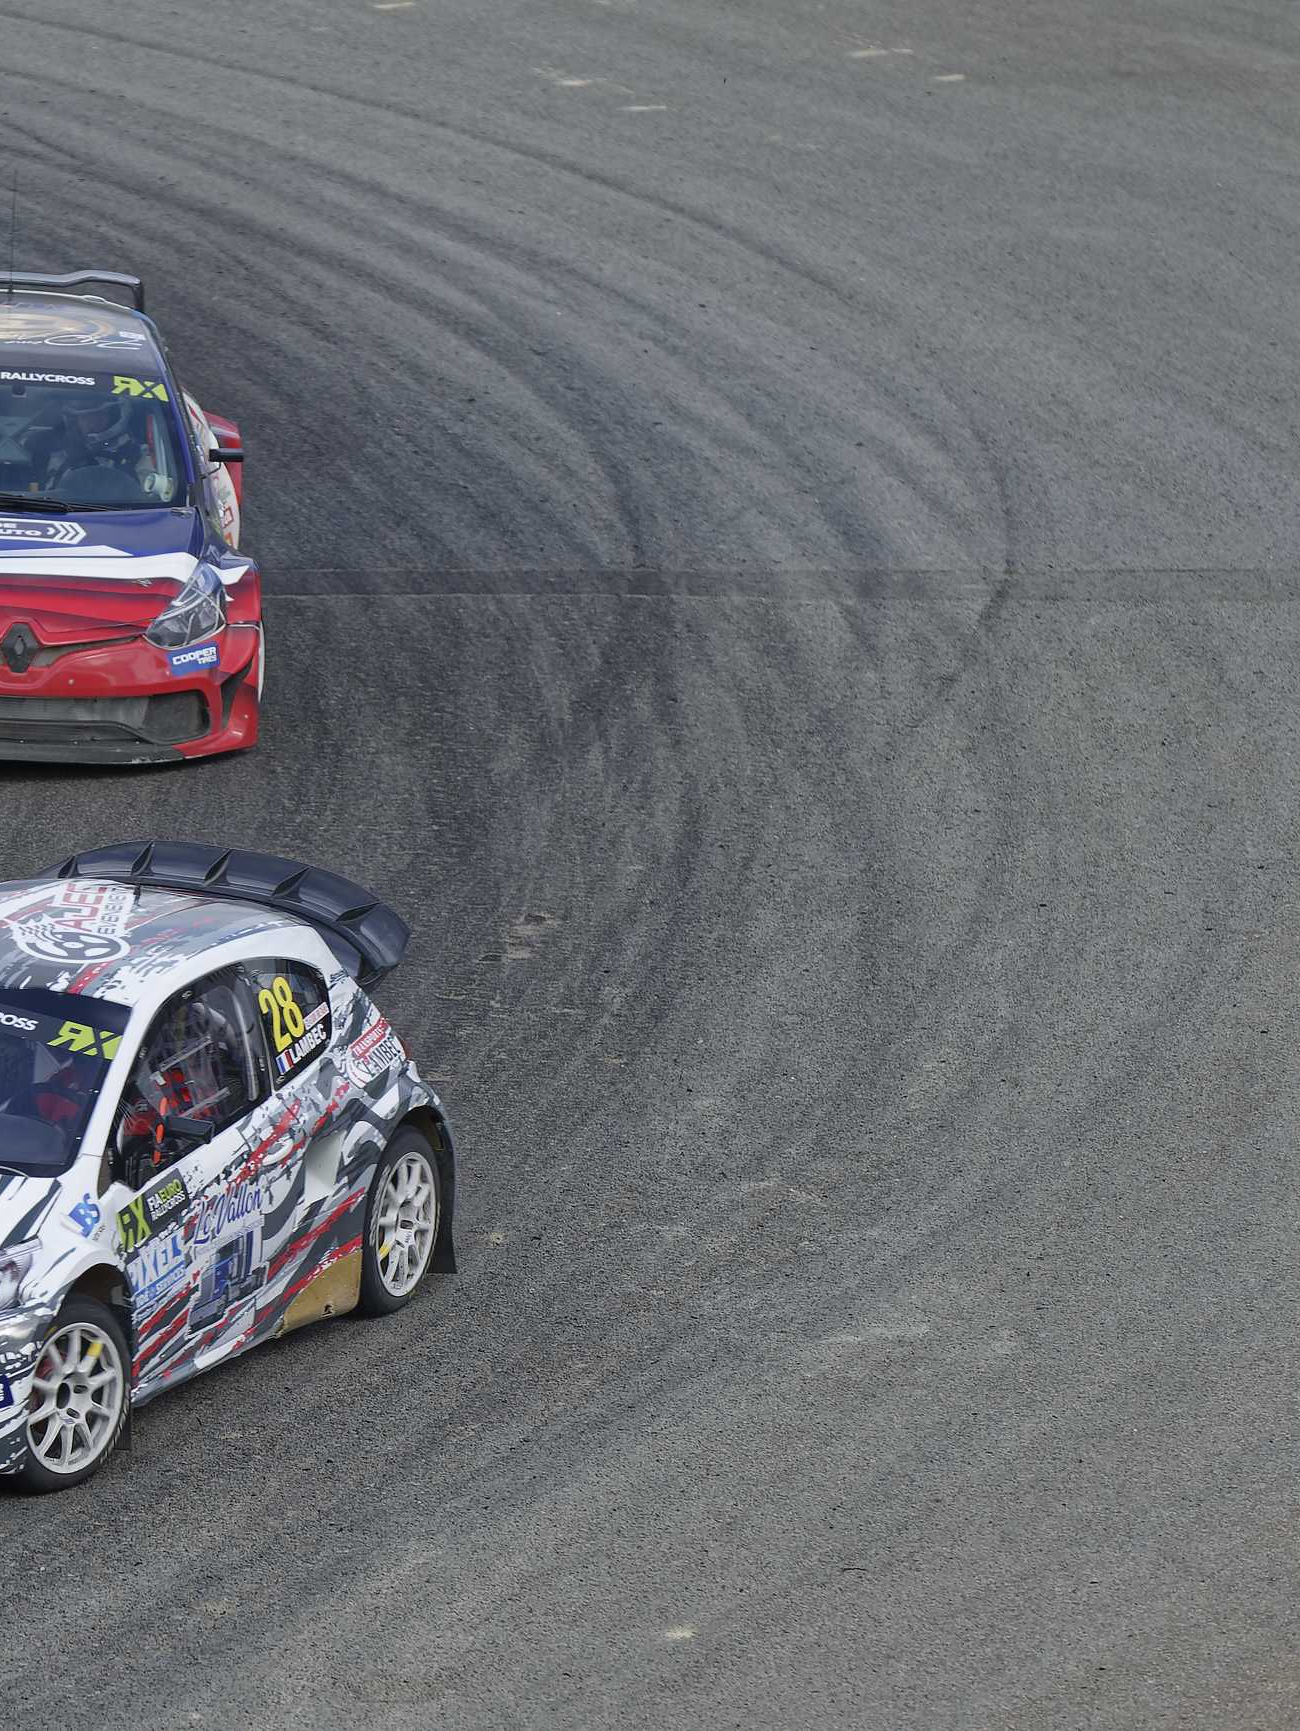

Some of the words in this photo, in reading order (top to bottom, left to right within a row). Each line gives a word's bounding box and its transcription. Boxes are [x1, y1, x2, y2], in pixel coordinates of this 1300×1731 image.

[0, 371, 95, 386] RALLYCROSS
[172, 646, 217, 665] COOPER
[258, 976, 305, 1053] 28
[289, 1023, 327, 1064] LAMBEC
